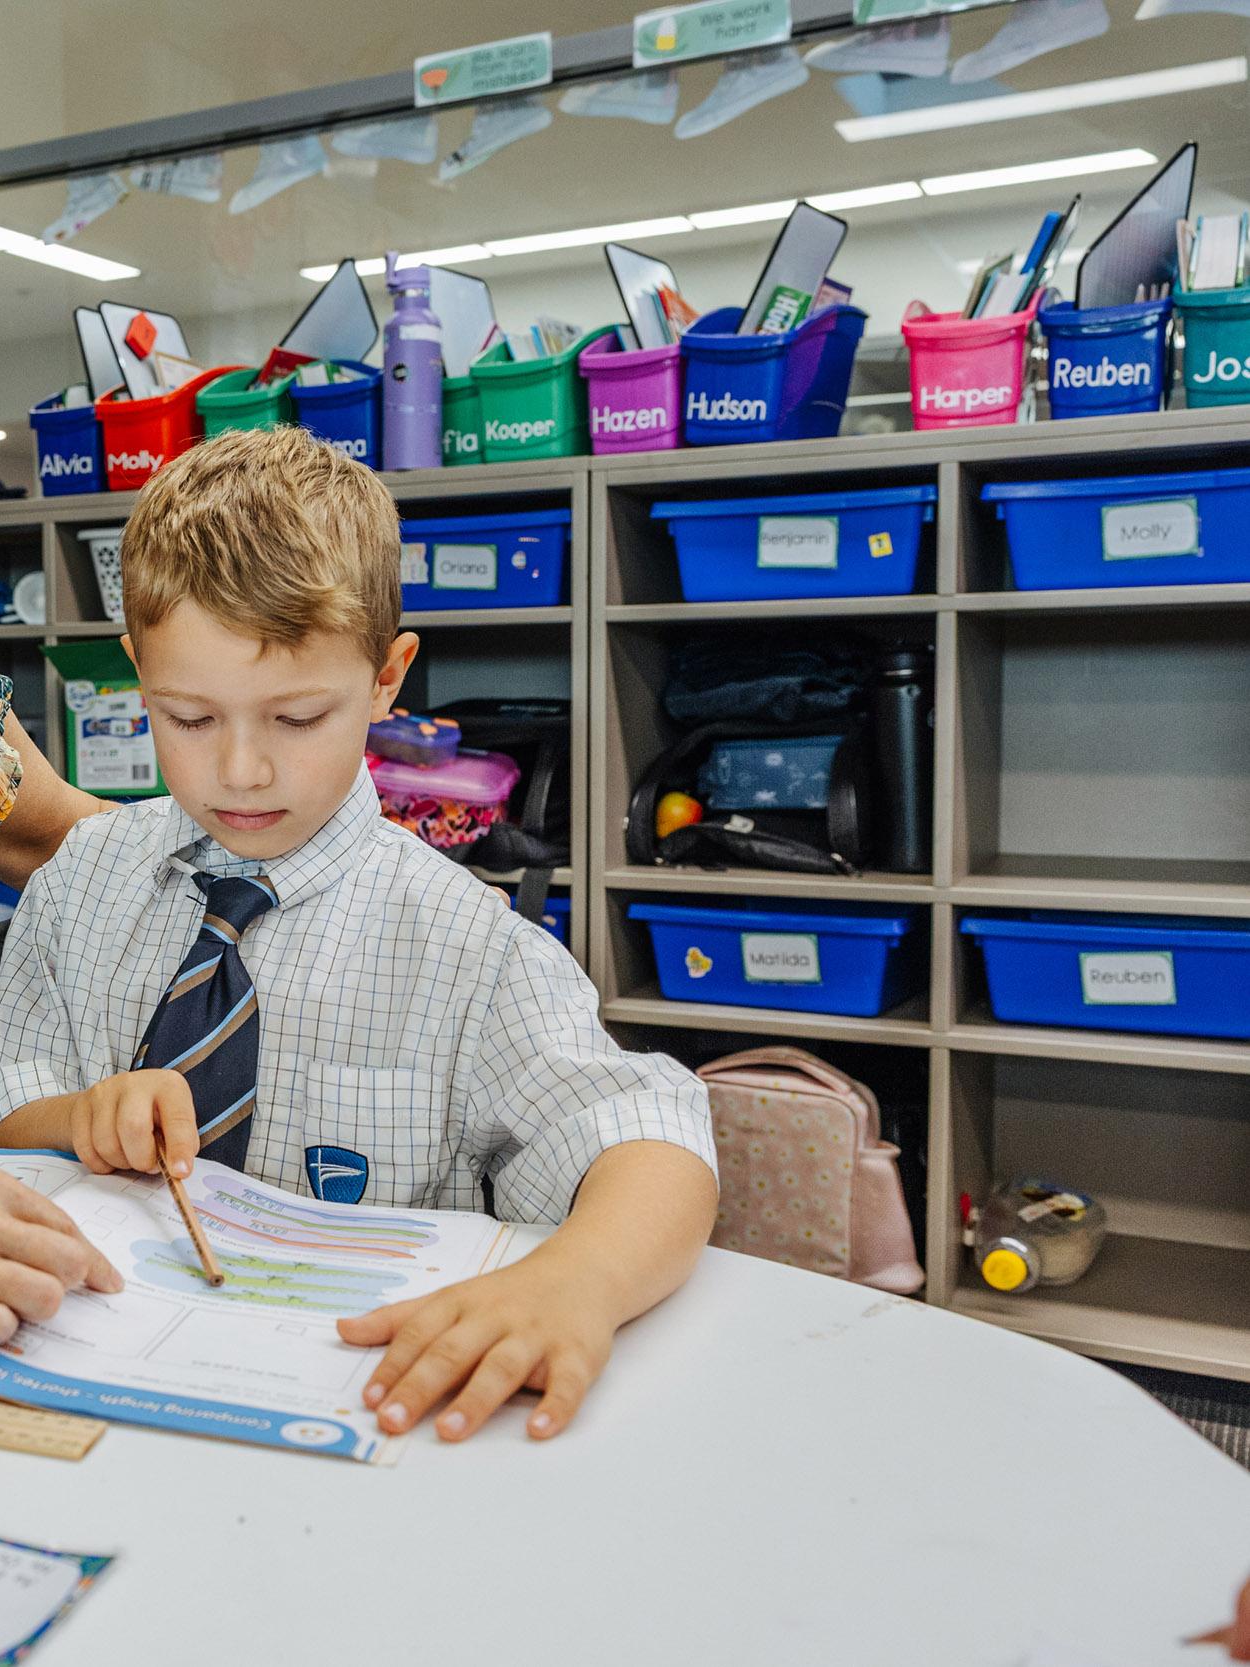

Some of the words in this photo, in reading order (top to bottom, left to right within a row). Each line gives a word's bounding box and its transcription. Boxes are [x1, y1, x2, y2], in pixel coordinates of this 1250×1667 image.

[730, 3, 770, 20] work
[715, 21, 757, 39] hard
[1053, 356, 1150, 388] Reuben
[686, 392, 767, 421] Hudson
[919, 385, 1012, 412] Harper
[485, 417, 555, 443] Kooper
[592, 405, 667, 434] Hazen
[107, 450, 164, 473] Molly
[761, 531, 830, 548] Benjamin
[1120, 523, 1171, 541] Molly
[440, 559, 488, 576] Oriana
[751, 952, 810, 967] Matilda
[1089, 969, 1166, 985] Reuben
[99, 1392, 161, 1414] length
[164, 1404, 272, 1431] Comparing
